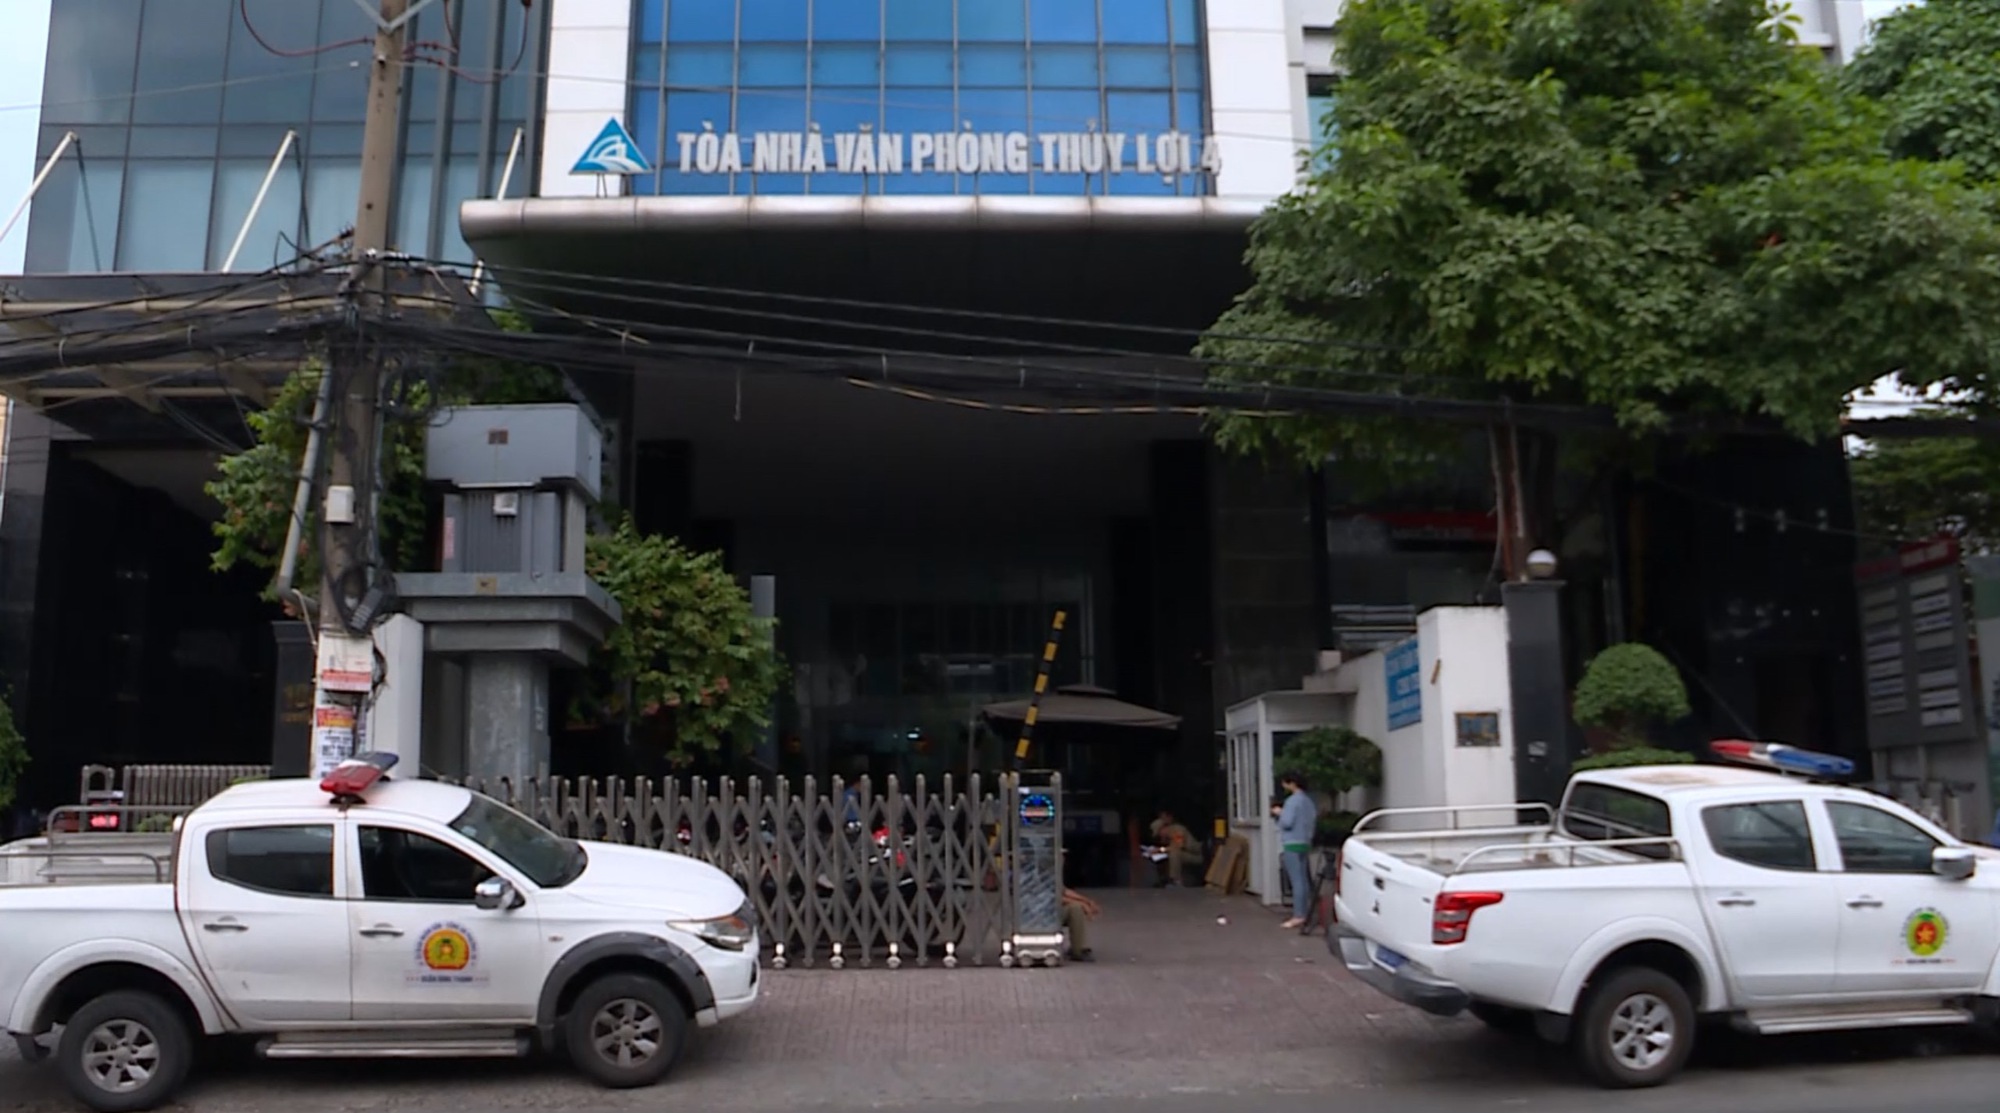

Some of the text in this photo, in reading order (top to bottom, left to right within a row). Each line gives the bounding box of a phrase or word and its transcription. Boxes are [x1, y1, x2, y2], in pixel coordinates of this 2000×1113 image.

[677, 121, 742, 173] TÒA
[755, 122, 826, 173] NHÀ
[834, 123, 902, 173] VĂN
[911, 120, 1028, 173] PHÒNG
[1039, 119, 1126, 173] THỦY
[1201, 135, 1222, 175] 4
